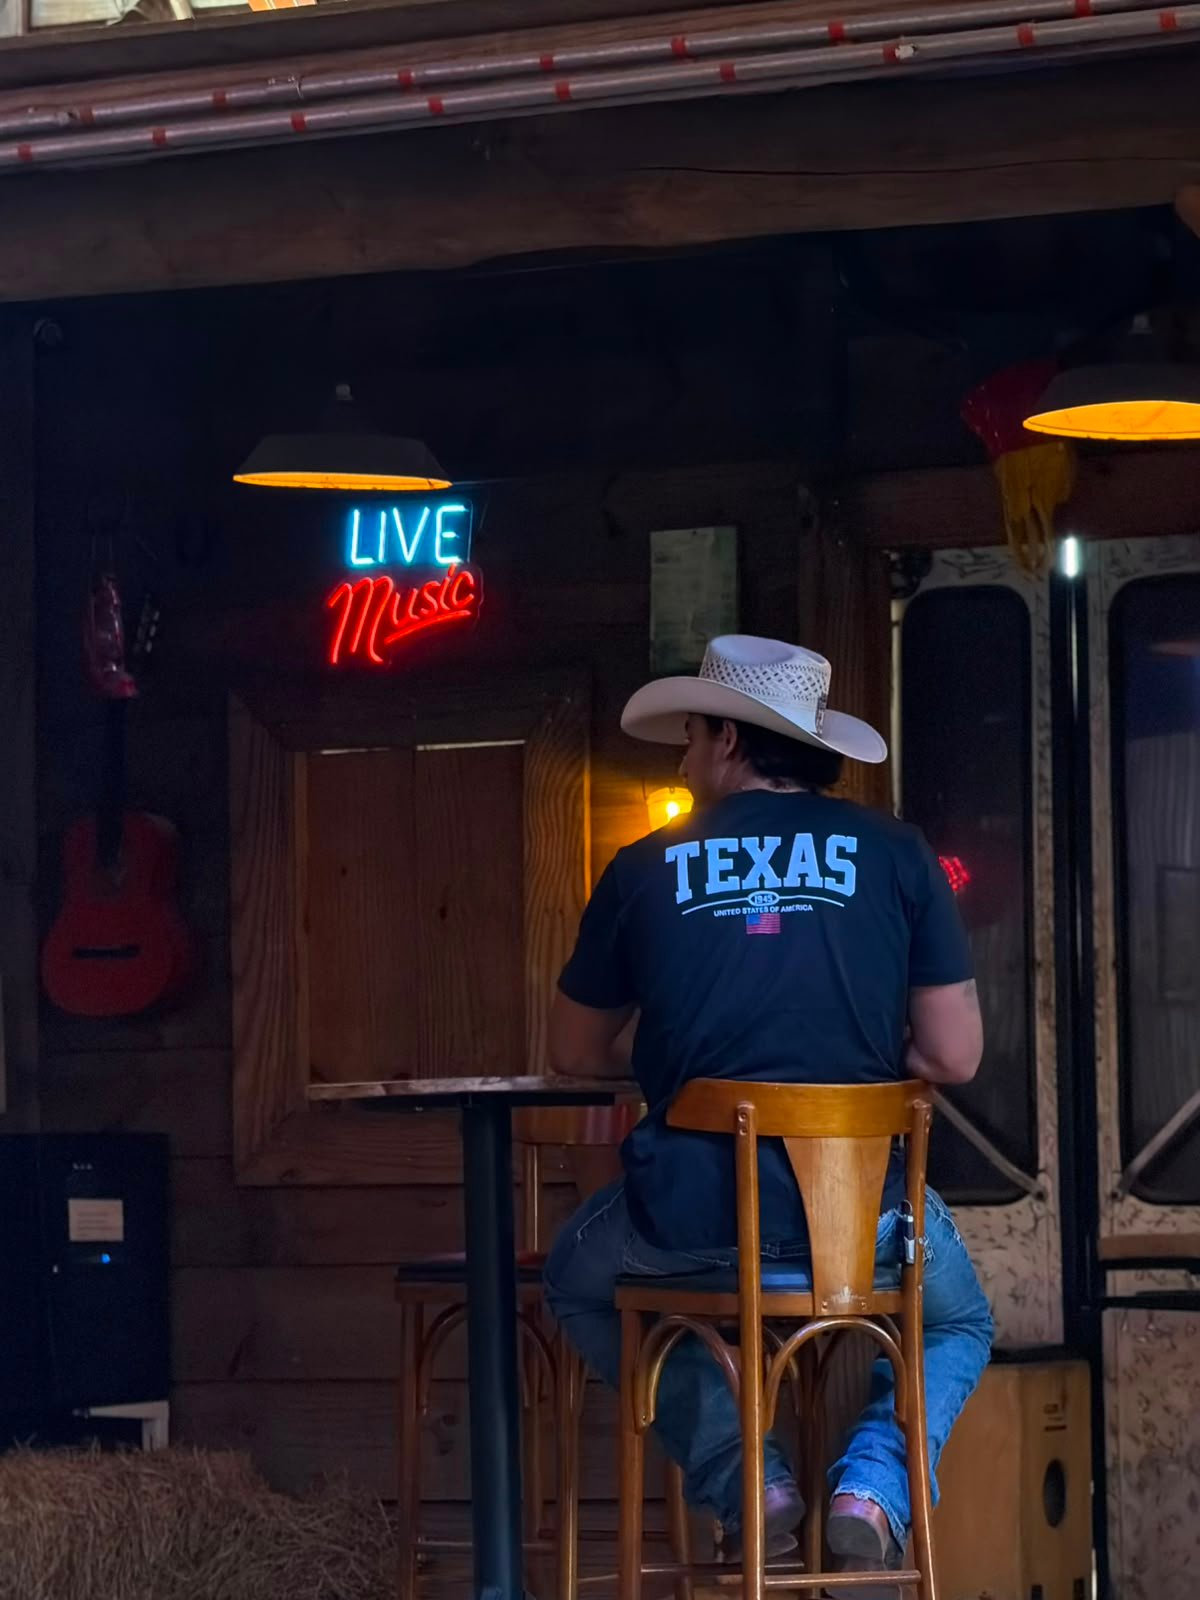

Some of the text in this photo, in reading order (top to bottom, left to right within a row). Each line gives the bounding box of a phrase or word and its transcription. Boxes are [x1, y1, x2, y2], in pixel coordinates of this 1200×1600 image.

[350, 504, 467, 565] LIVE
[327, 562, 476, 665] Music
[665, 833, 858, 904] TEXAS
[713, 908, 741, 917] UNITED
[769, 905, 780, 913] OF
[780, 904, 813, 912] AMERICA
